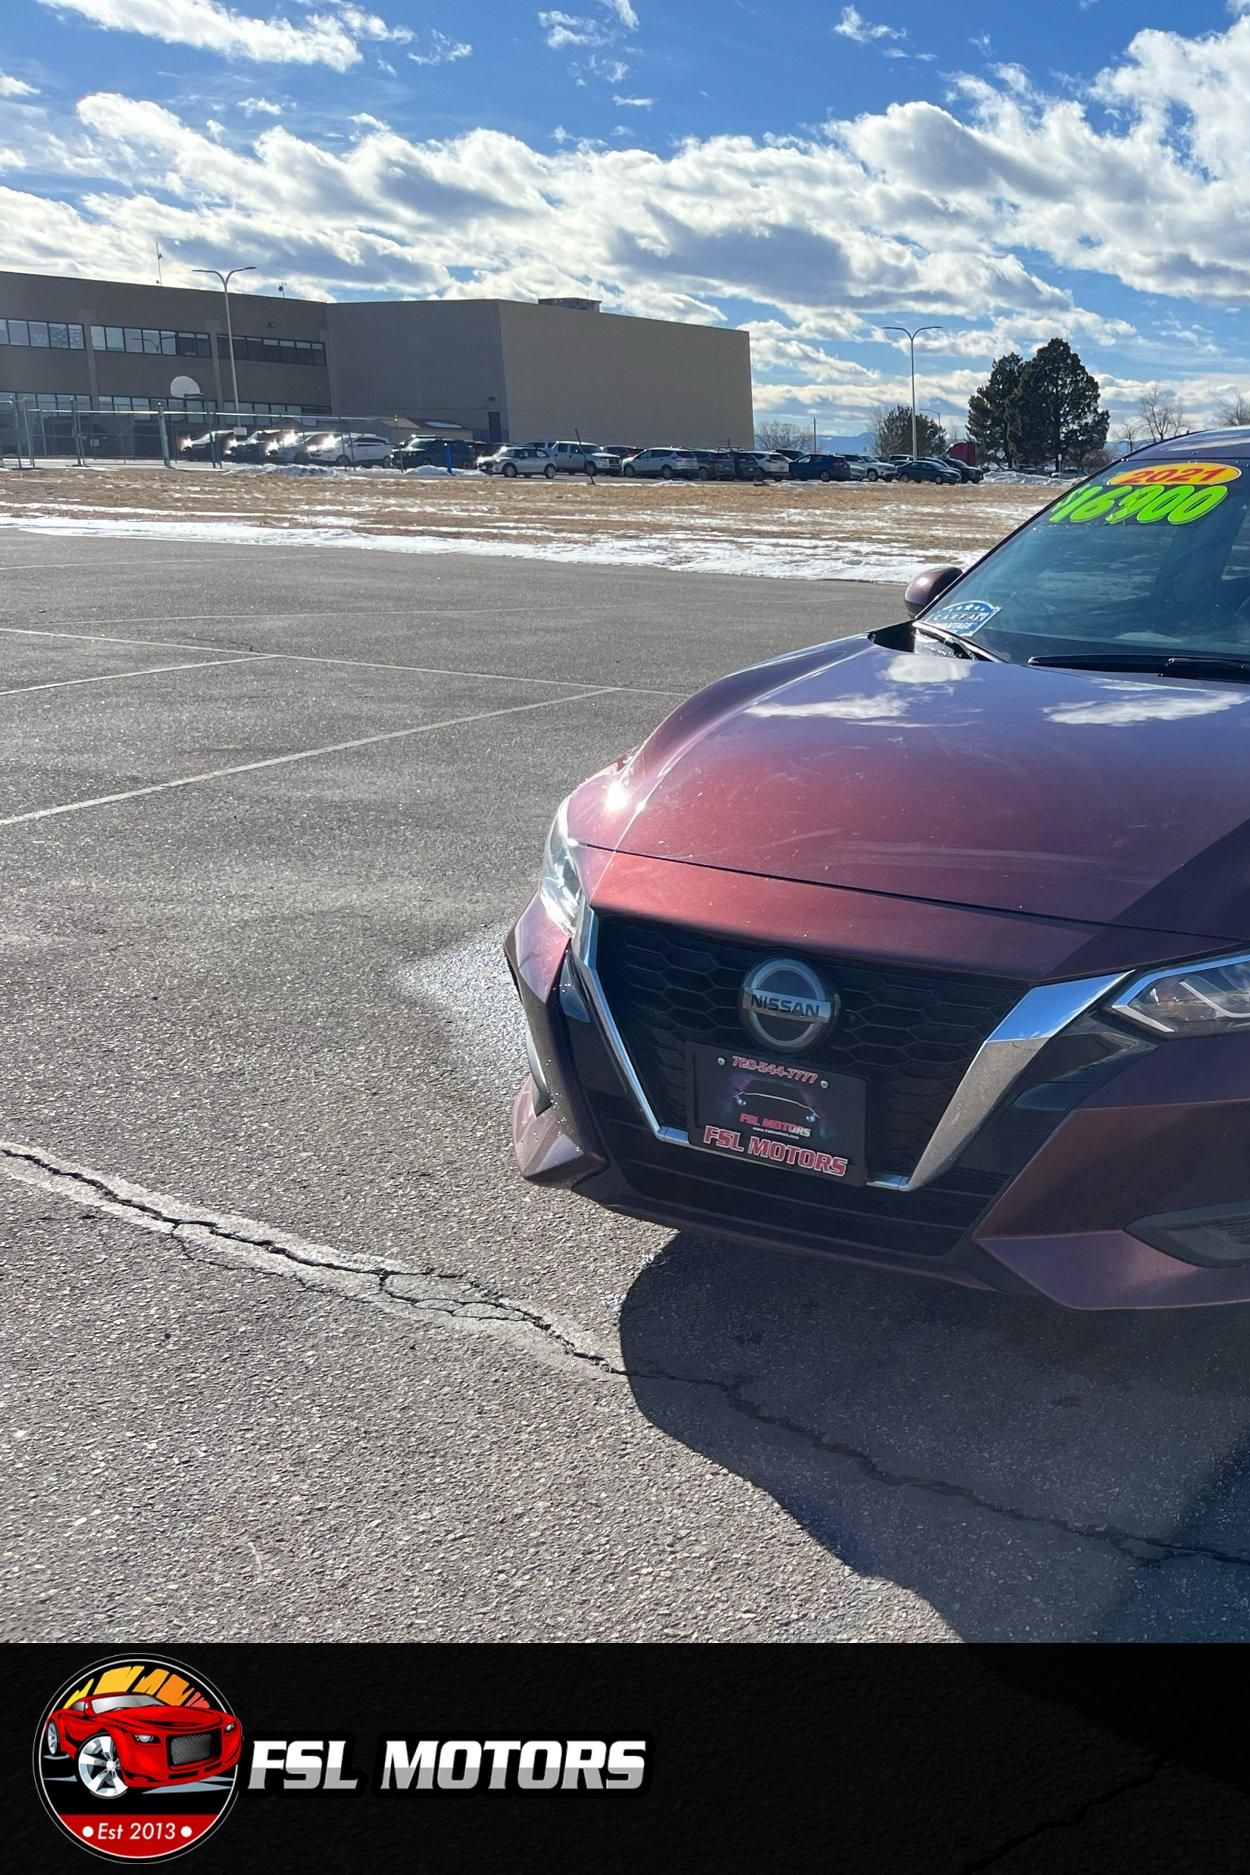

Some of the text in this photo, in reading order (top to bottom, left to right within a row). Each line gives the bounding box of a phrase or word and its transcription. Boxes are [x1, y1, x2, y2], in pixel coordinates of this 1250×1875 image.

[1123, 467, 1226, 484] 2021
[751, 994, 820, 1017] NISSAN
[732, 1055, 818, 1084] 720-544-7777
[762, 1118, 812, 1138] MOTORS
[703, 1125, 848, 1177] FSL MOTORS
